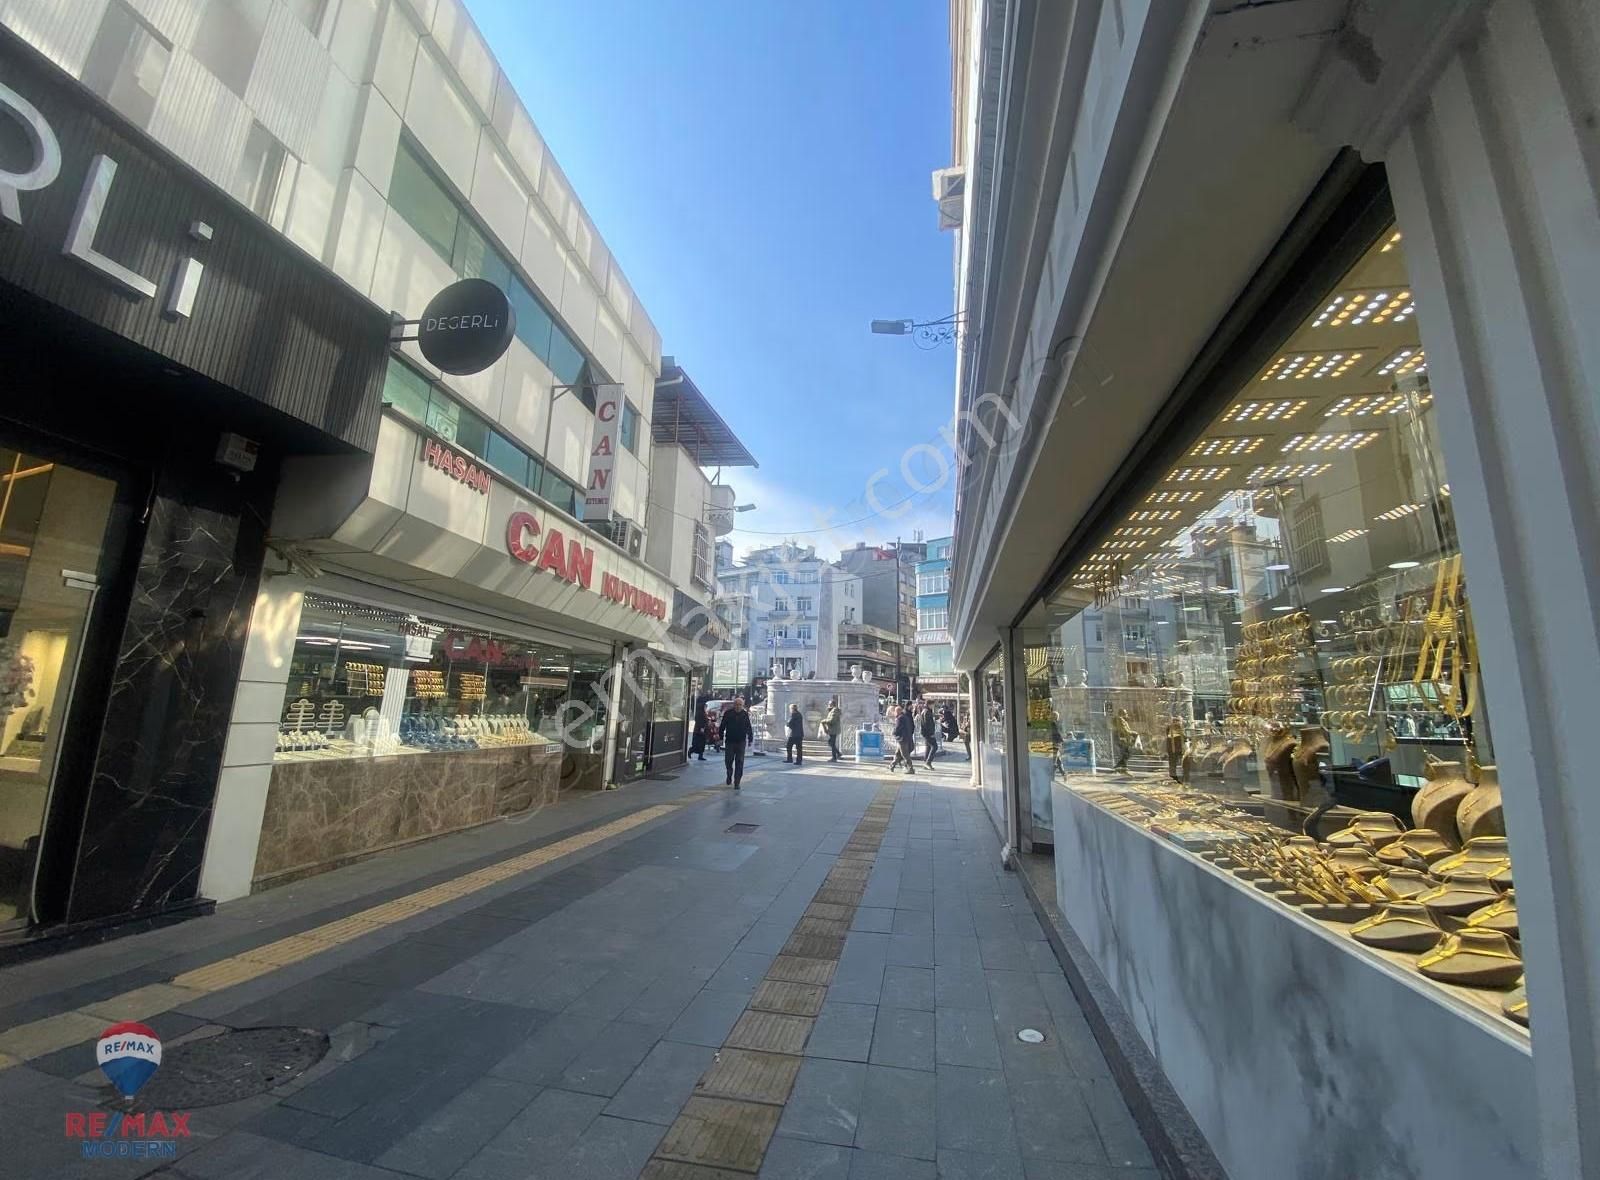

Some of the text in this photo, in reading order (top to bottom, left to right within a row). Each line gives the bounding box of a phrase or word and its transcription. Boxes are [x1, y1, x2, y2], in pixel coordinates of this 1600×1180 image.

[591, 401, 617, 490] CAN
[424, 438, 492, 495] HASAN
[506, 511, 594, 591] CAN
